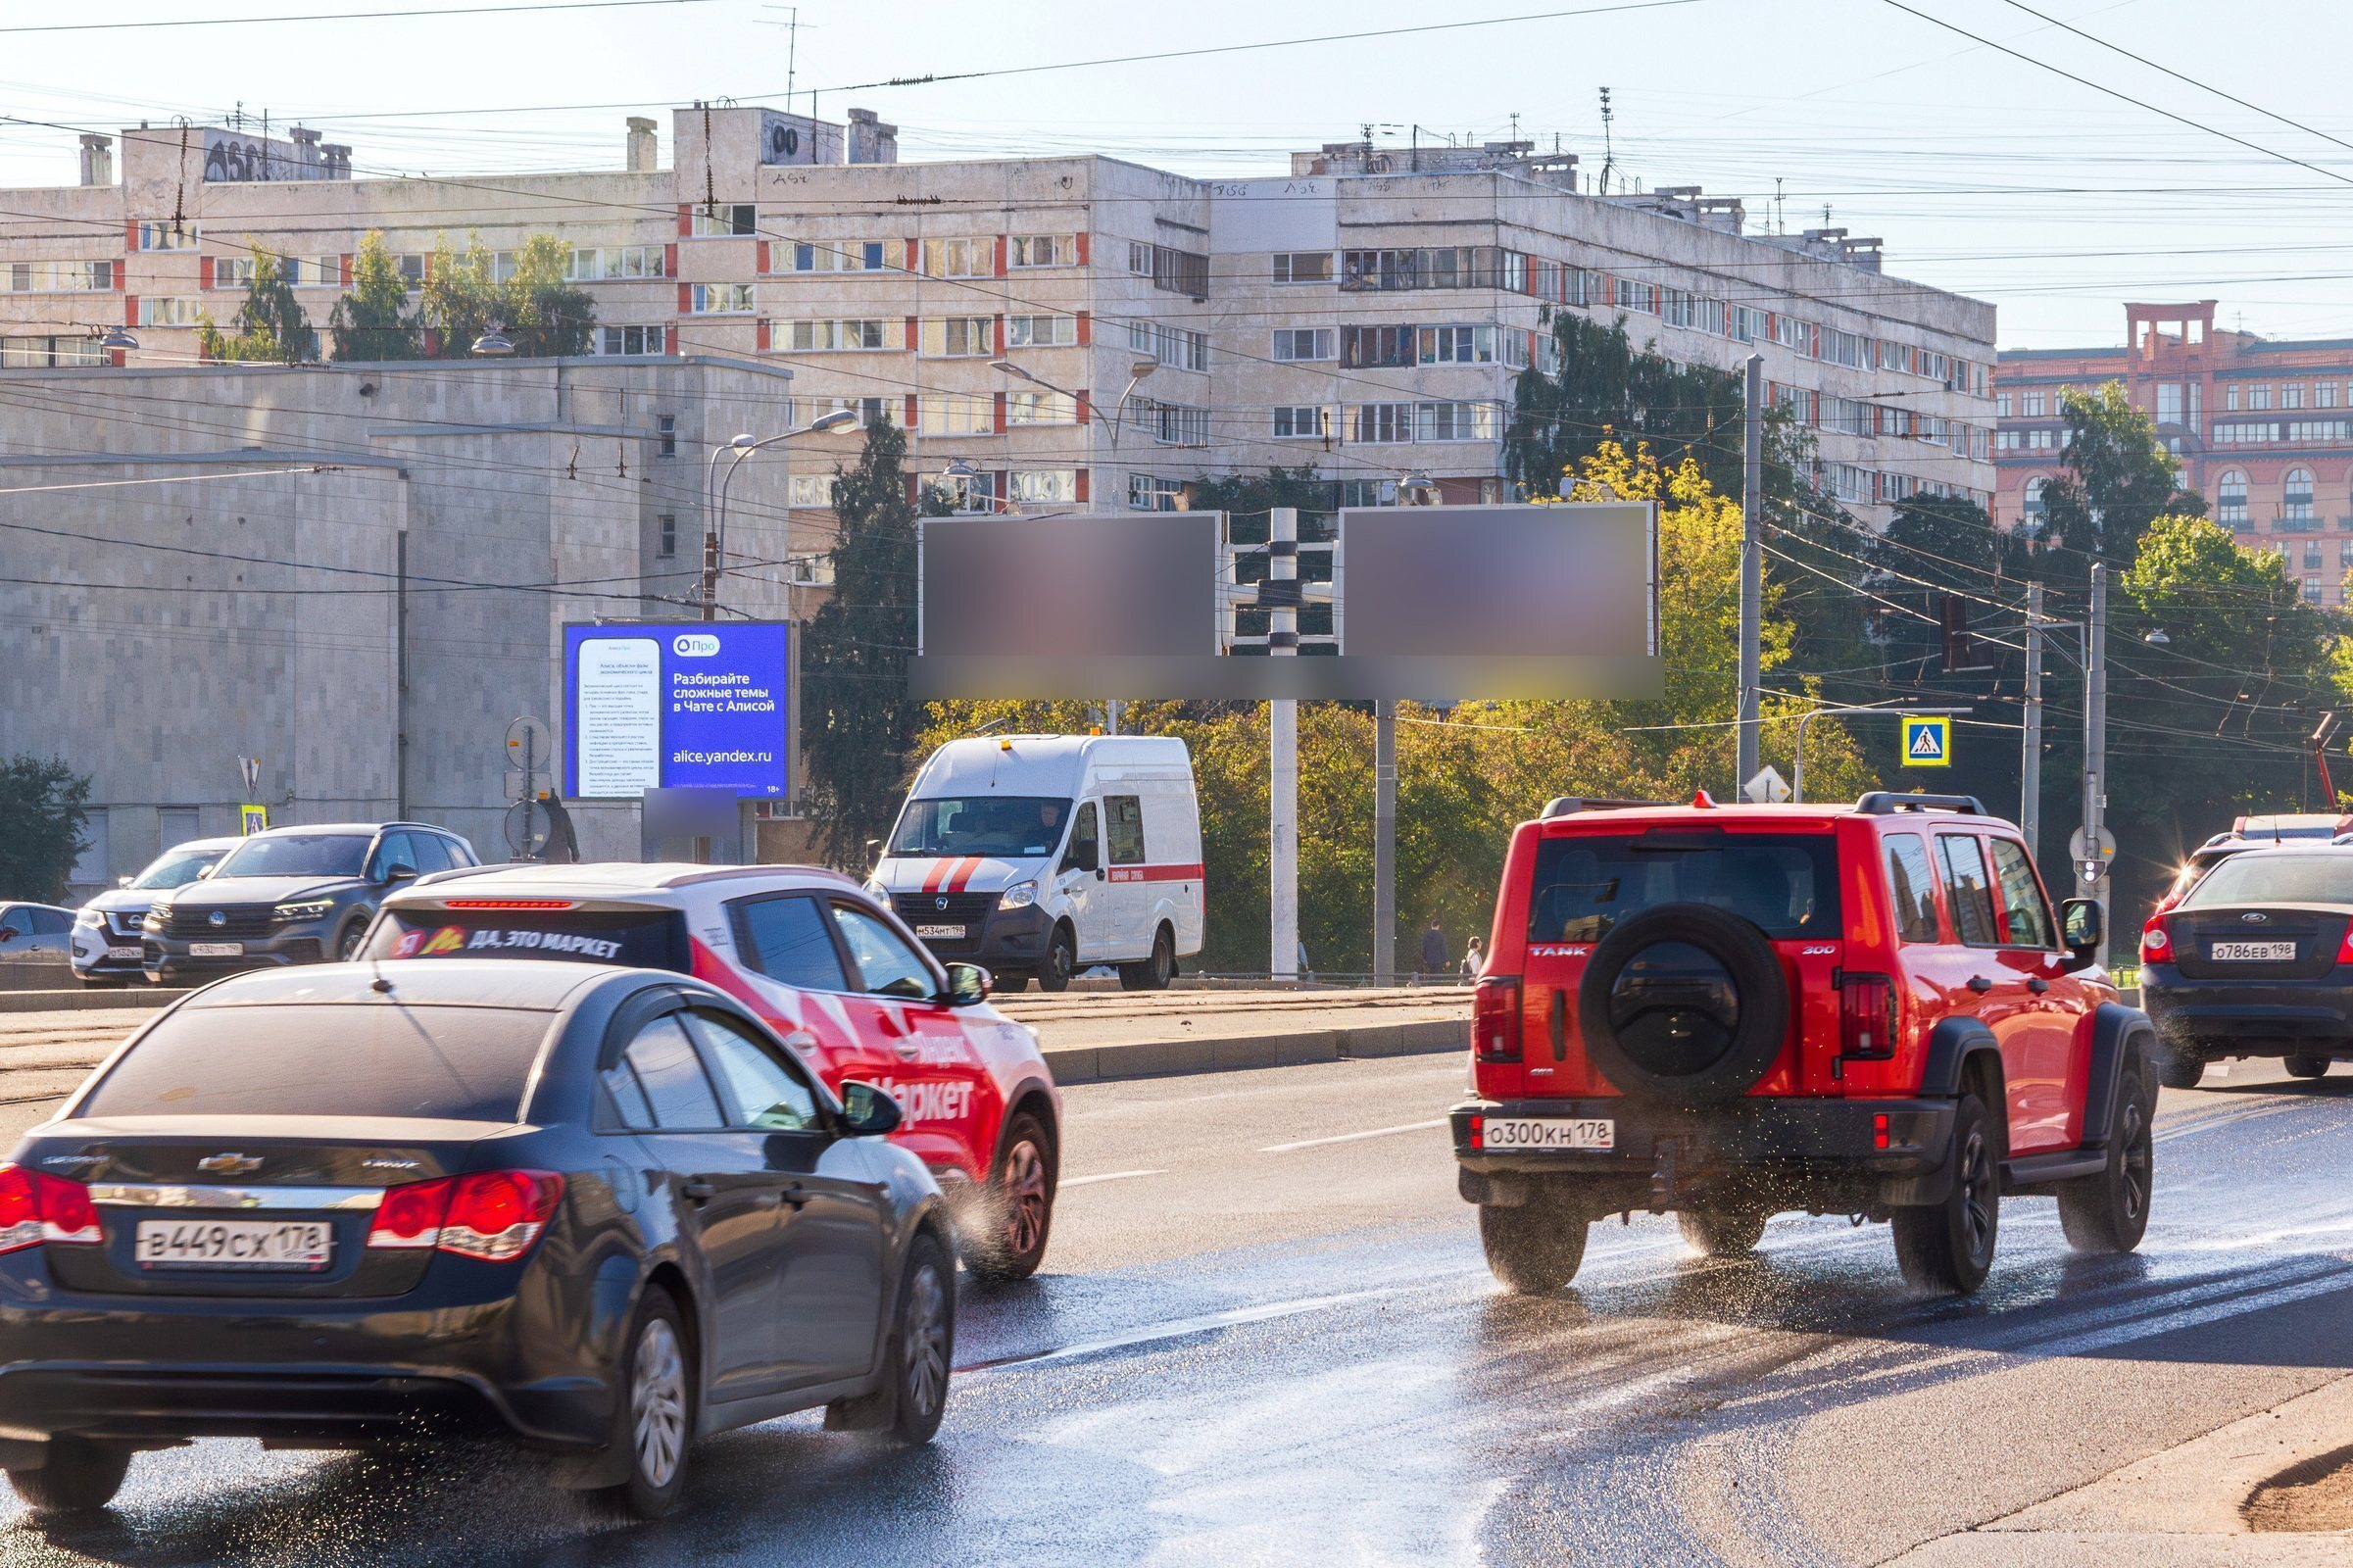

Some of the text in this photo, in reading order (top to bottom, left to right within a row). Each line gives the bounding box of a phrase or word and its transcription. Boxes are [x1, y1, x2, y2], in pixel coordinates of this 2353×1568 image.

[692, 640, 715, 654] Про
[673, 671, 751, 687] Разбирайте
[673, 689, 769, 699] сложные темы
[673, 699, 775, 712] в Чате с Алисой
[673, 749, 772, 765] alice.yandex.ru
[766, 785, 780, 794] 18+
[502, 930, 542, 948] ЭТО
[540, 932, 623, 959] МАРКЕТ
[1802, 946, 1836, 956] 300
[1530, 947, 1588, 956] TANK
[2216, 945, 2269, 958] О786ЕВ
[1490, 1122, 1572, 1145] О300КН
[148, 1225, 270, 1257] В449СХ
